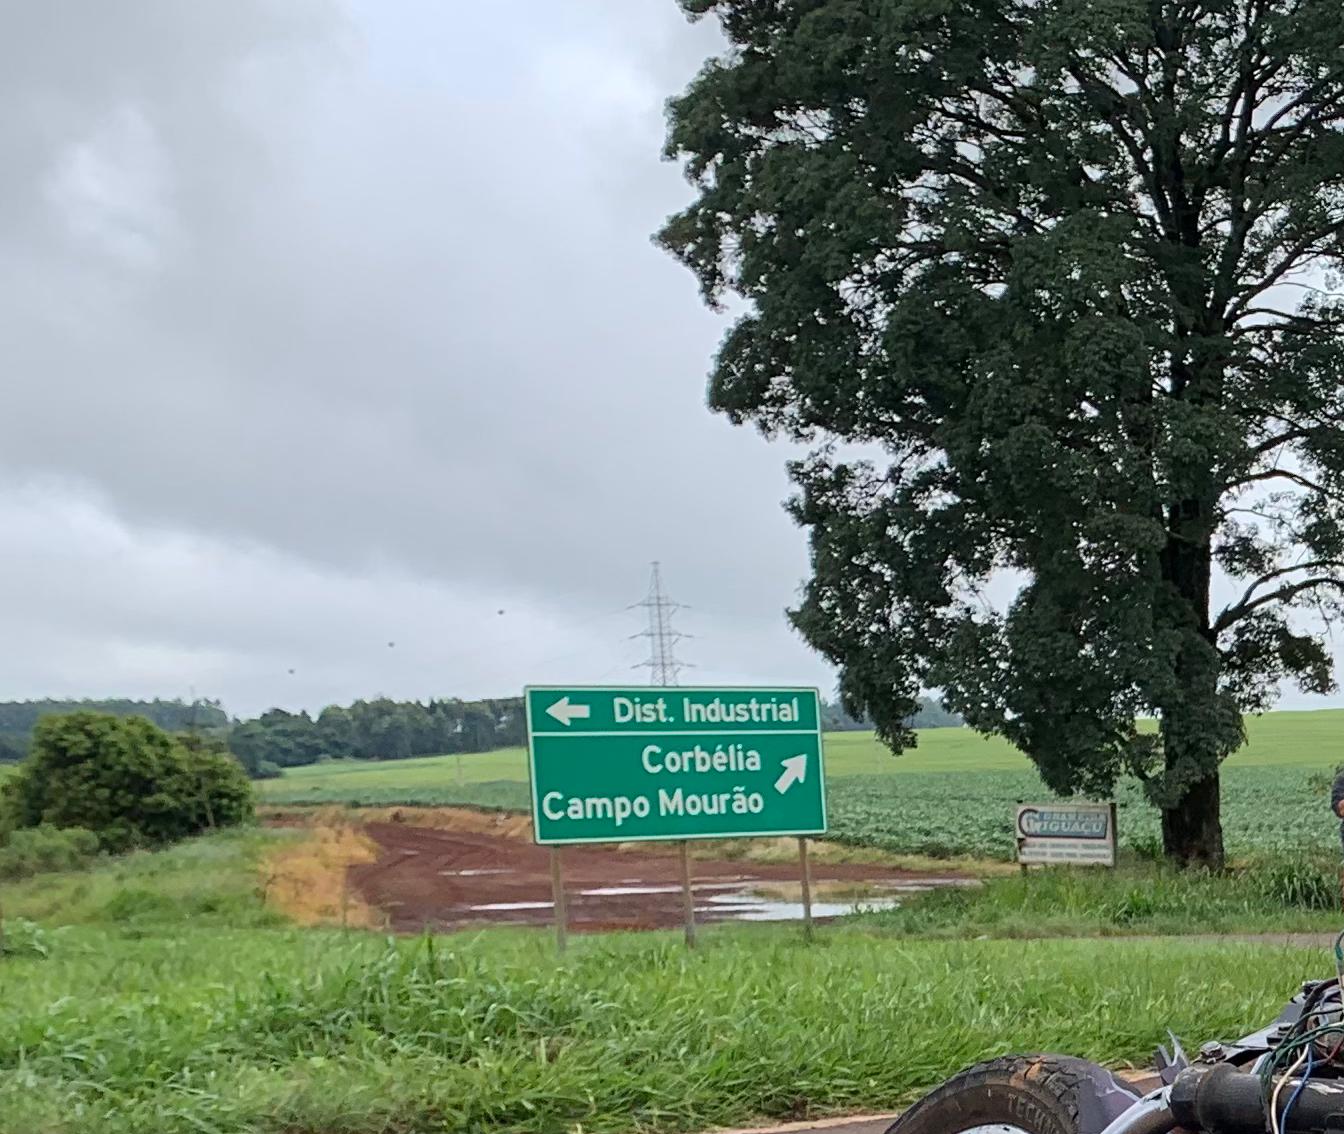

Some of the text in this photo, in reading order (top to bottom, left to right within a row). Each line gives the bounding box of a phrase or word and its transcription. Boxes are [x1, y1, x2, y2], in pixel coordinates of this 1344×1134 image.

[613, 697, 799, 723] Dist. Industrial
[641, 743, 761, 774] Corbélia
[542, 786, 764, 826] Campo Mourão
